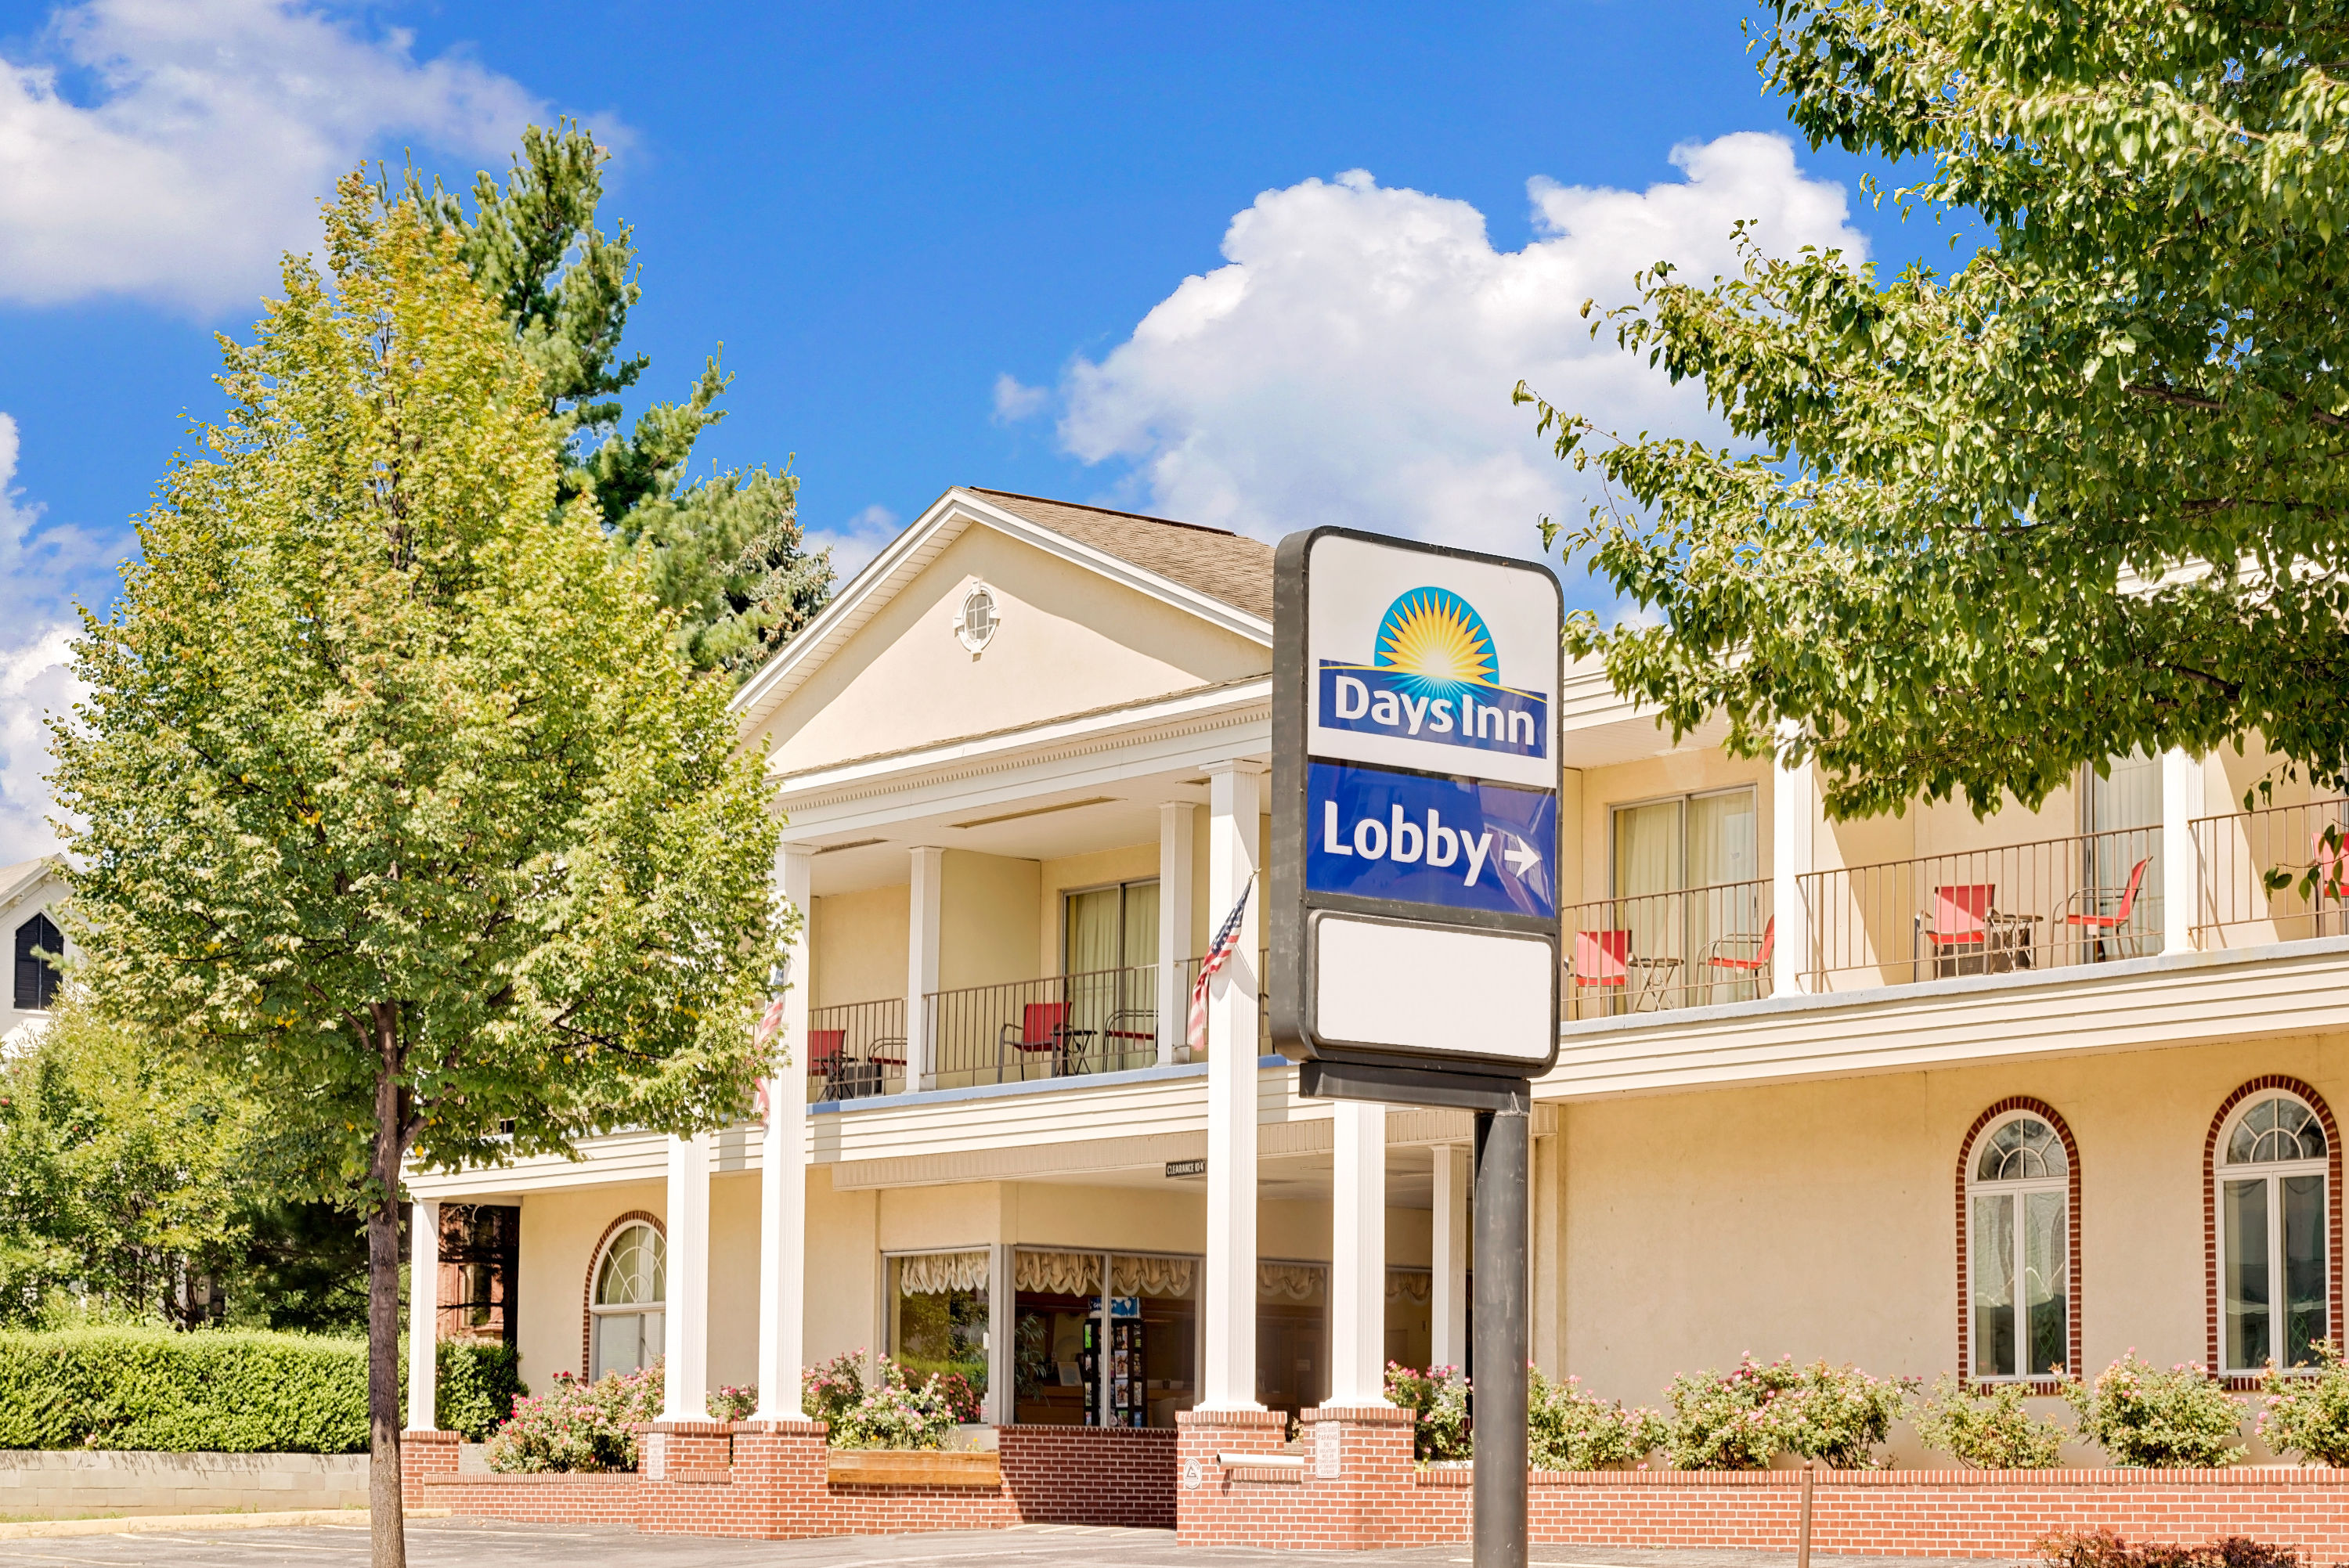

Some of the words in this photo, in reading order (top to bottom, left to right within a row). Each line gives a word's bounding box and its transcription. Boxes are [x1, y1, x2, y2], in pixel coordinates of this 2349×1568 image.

[1335, 675, 1454, 735] Days
[1462, 694, 1535, 746] Inn
[1324, 800, 1493, 887] Lobby
[1167, 1162, 1194, 1175] CLEARANCE
